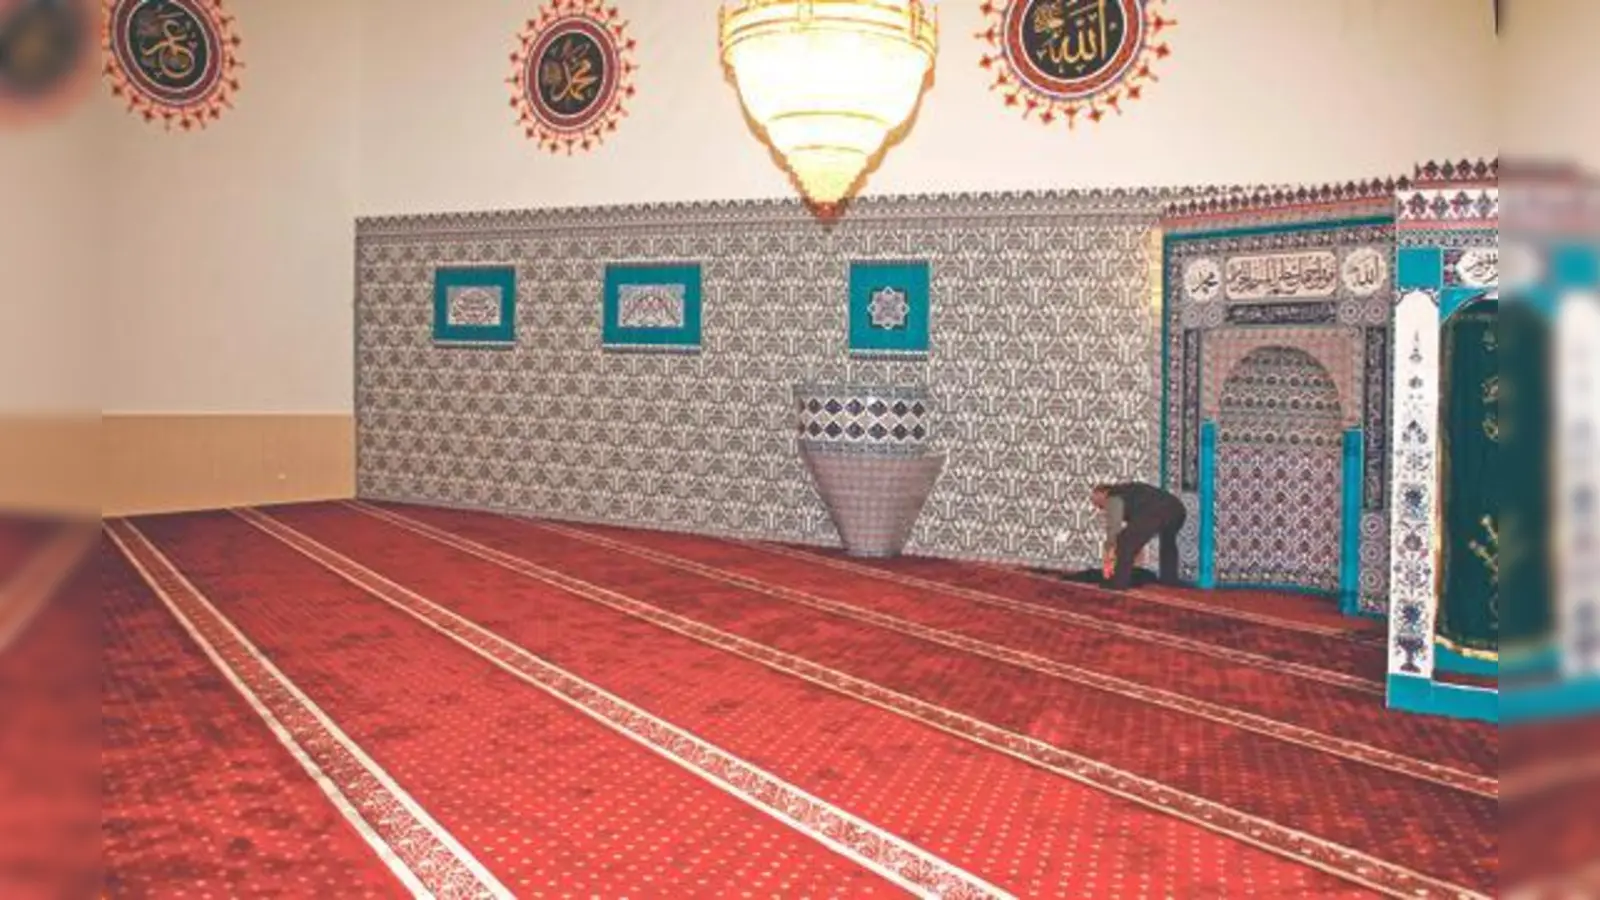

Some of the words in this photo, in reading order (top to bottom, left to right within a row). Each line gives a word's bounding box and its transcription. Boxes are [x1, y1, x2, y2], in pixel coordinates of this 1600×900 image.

[1044, 0, 1106, 64] الله
[1190, 271, 1219, 294] محمد
[1352, 254, 1379, 287] الله
